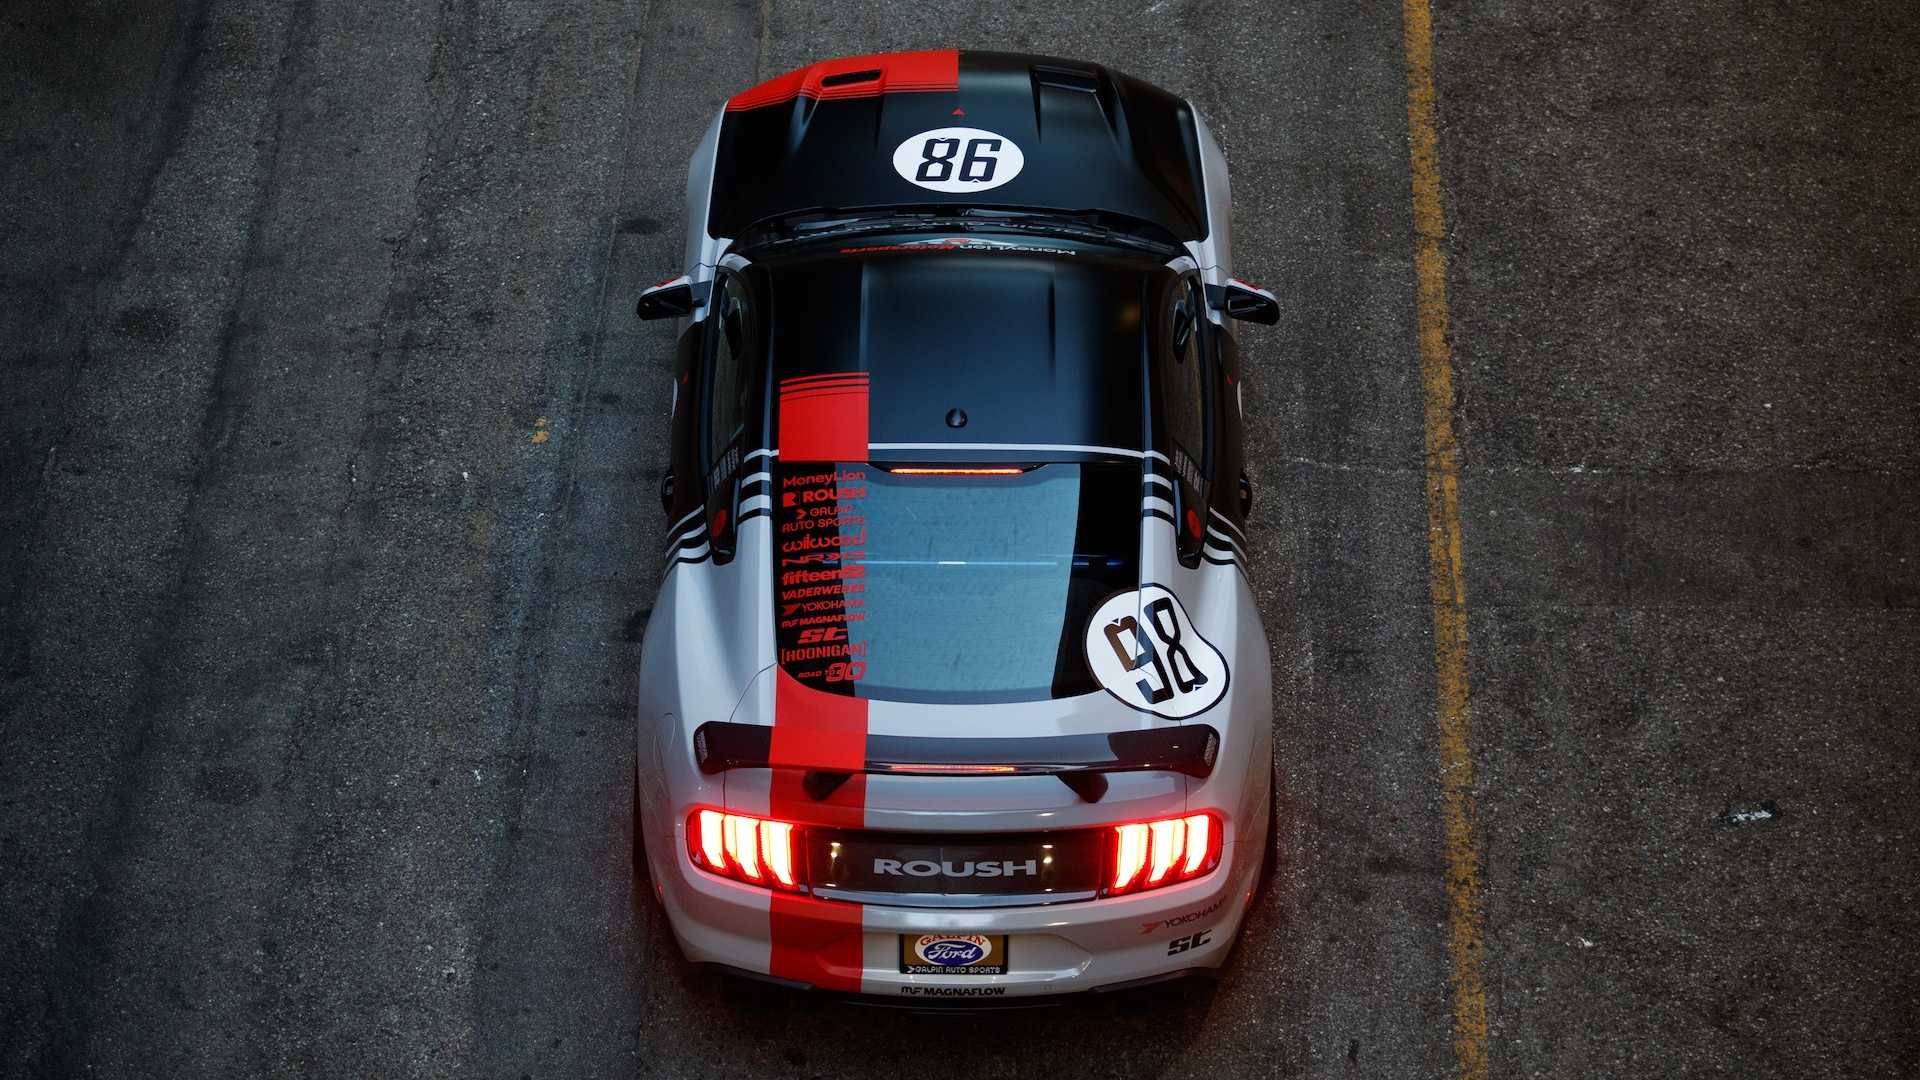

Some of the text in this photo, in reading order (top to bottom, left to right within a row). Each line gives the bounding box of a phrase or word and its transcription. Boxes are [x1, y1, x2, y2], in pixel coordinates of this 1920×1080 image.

[782, 516, 864, 533] AUTO SPO
[783, 565, 864, 585] fifteen
[782, 584, 864, 601] VADERWE
[801, 600, 864, 613] YOKOHA
[799, 612, 864, 626] MAGNAF
[873, 858, 1037, 877] ROUSH
[928, 943, 976, 960] Ford
[945, 966, 966, 974] AUTO
[969, 966, 1001, 974] SPORTS
[924, 987, 1005, 997] MAGNAFLOW
